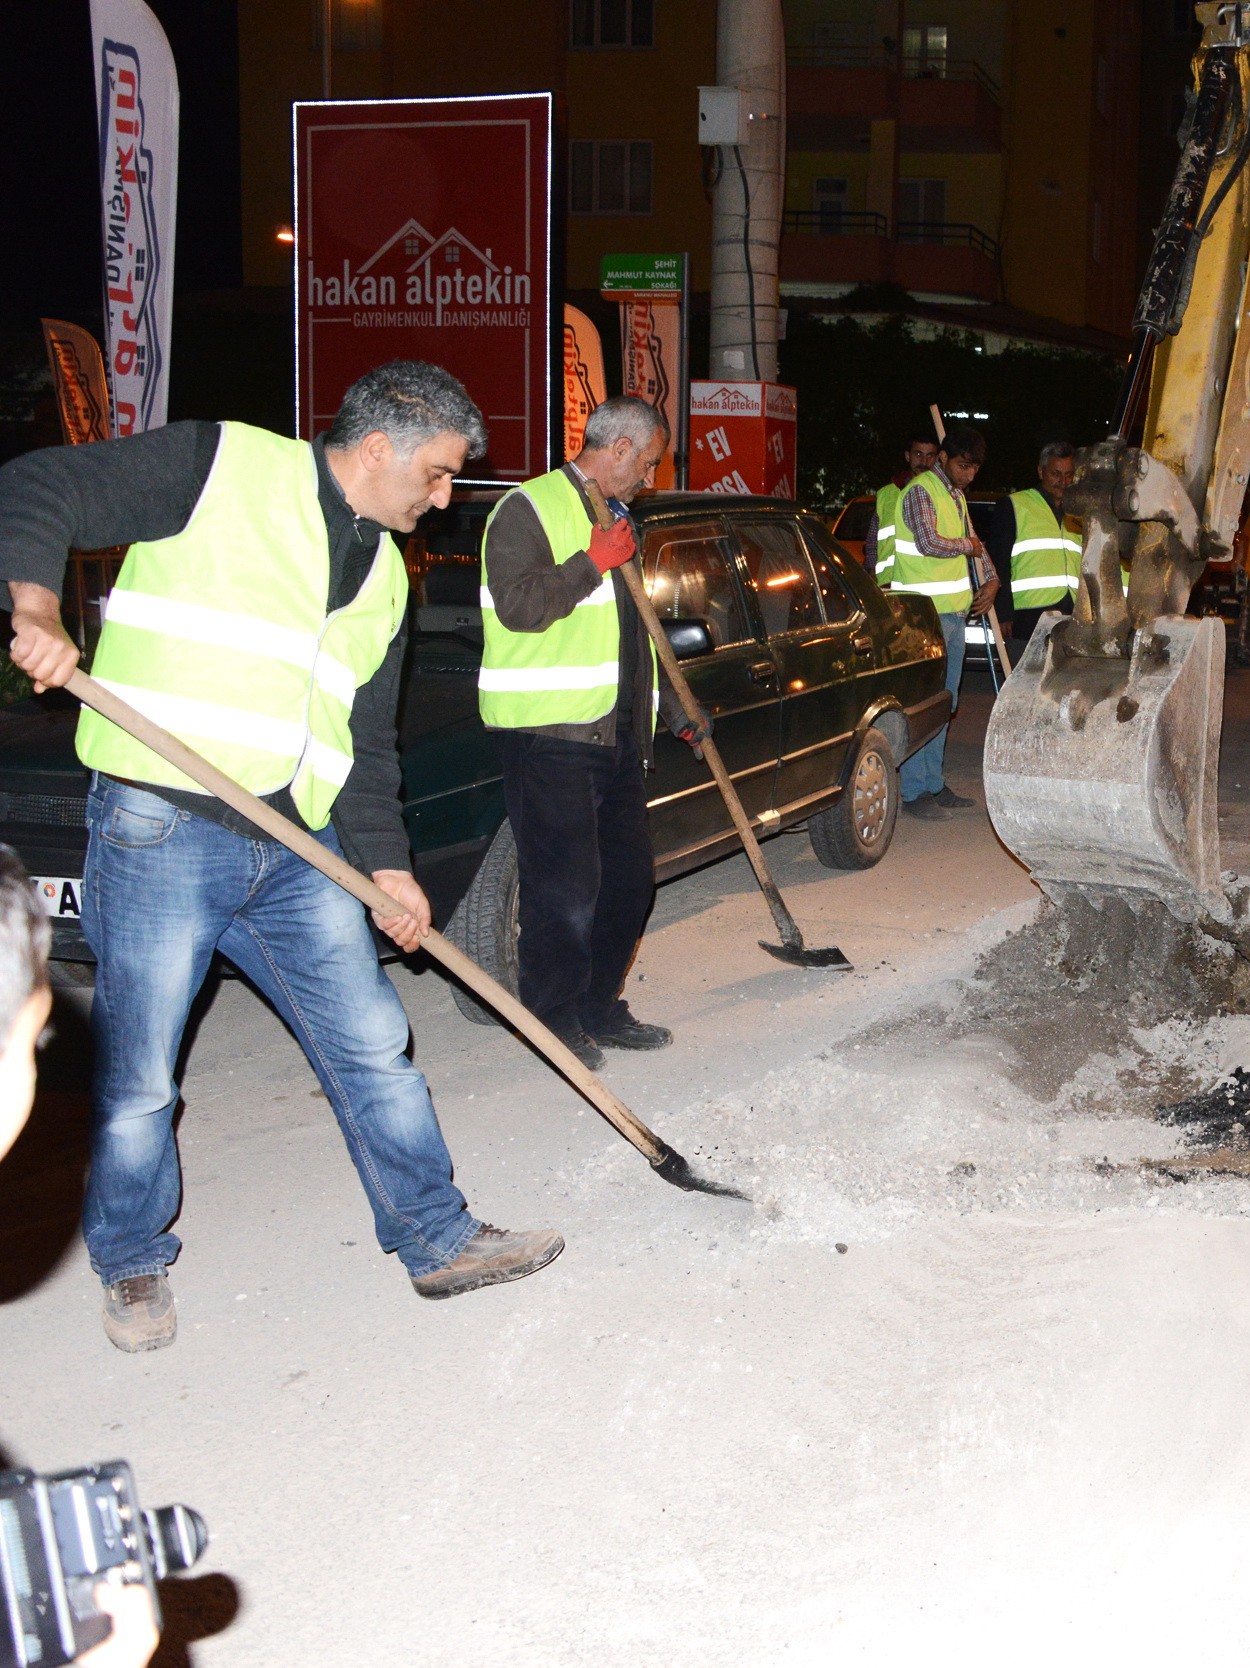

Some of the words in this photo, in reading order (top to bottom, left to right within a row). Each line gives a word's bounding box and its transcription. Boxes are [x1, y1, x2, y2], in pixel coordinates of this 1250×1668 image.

[654, 259, 677, 270] ŞEHİT
[607, 271, 643, 279] MAHMUT
[645, 271, 677, 279] KAYNAK
[307, 259, 396, 306] hakan
[406, 249, 531, 326] alptekin
[651, 281, 677, 289] SOKAĞI
[353, 309, 435, 327] GAYRİMENKUL
[443, 308, 531, 330] DANIŞMANLIĞI
[692, 397, 719, 409] hakan
[722, 396, 760, 411] alptekin
[705, 426, 732, 462] EV
